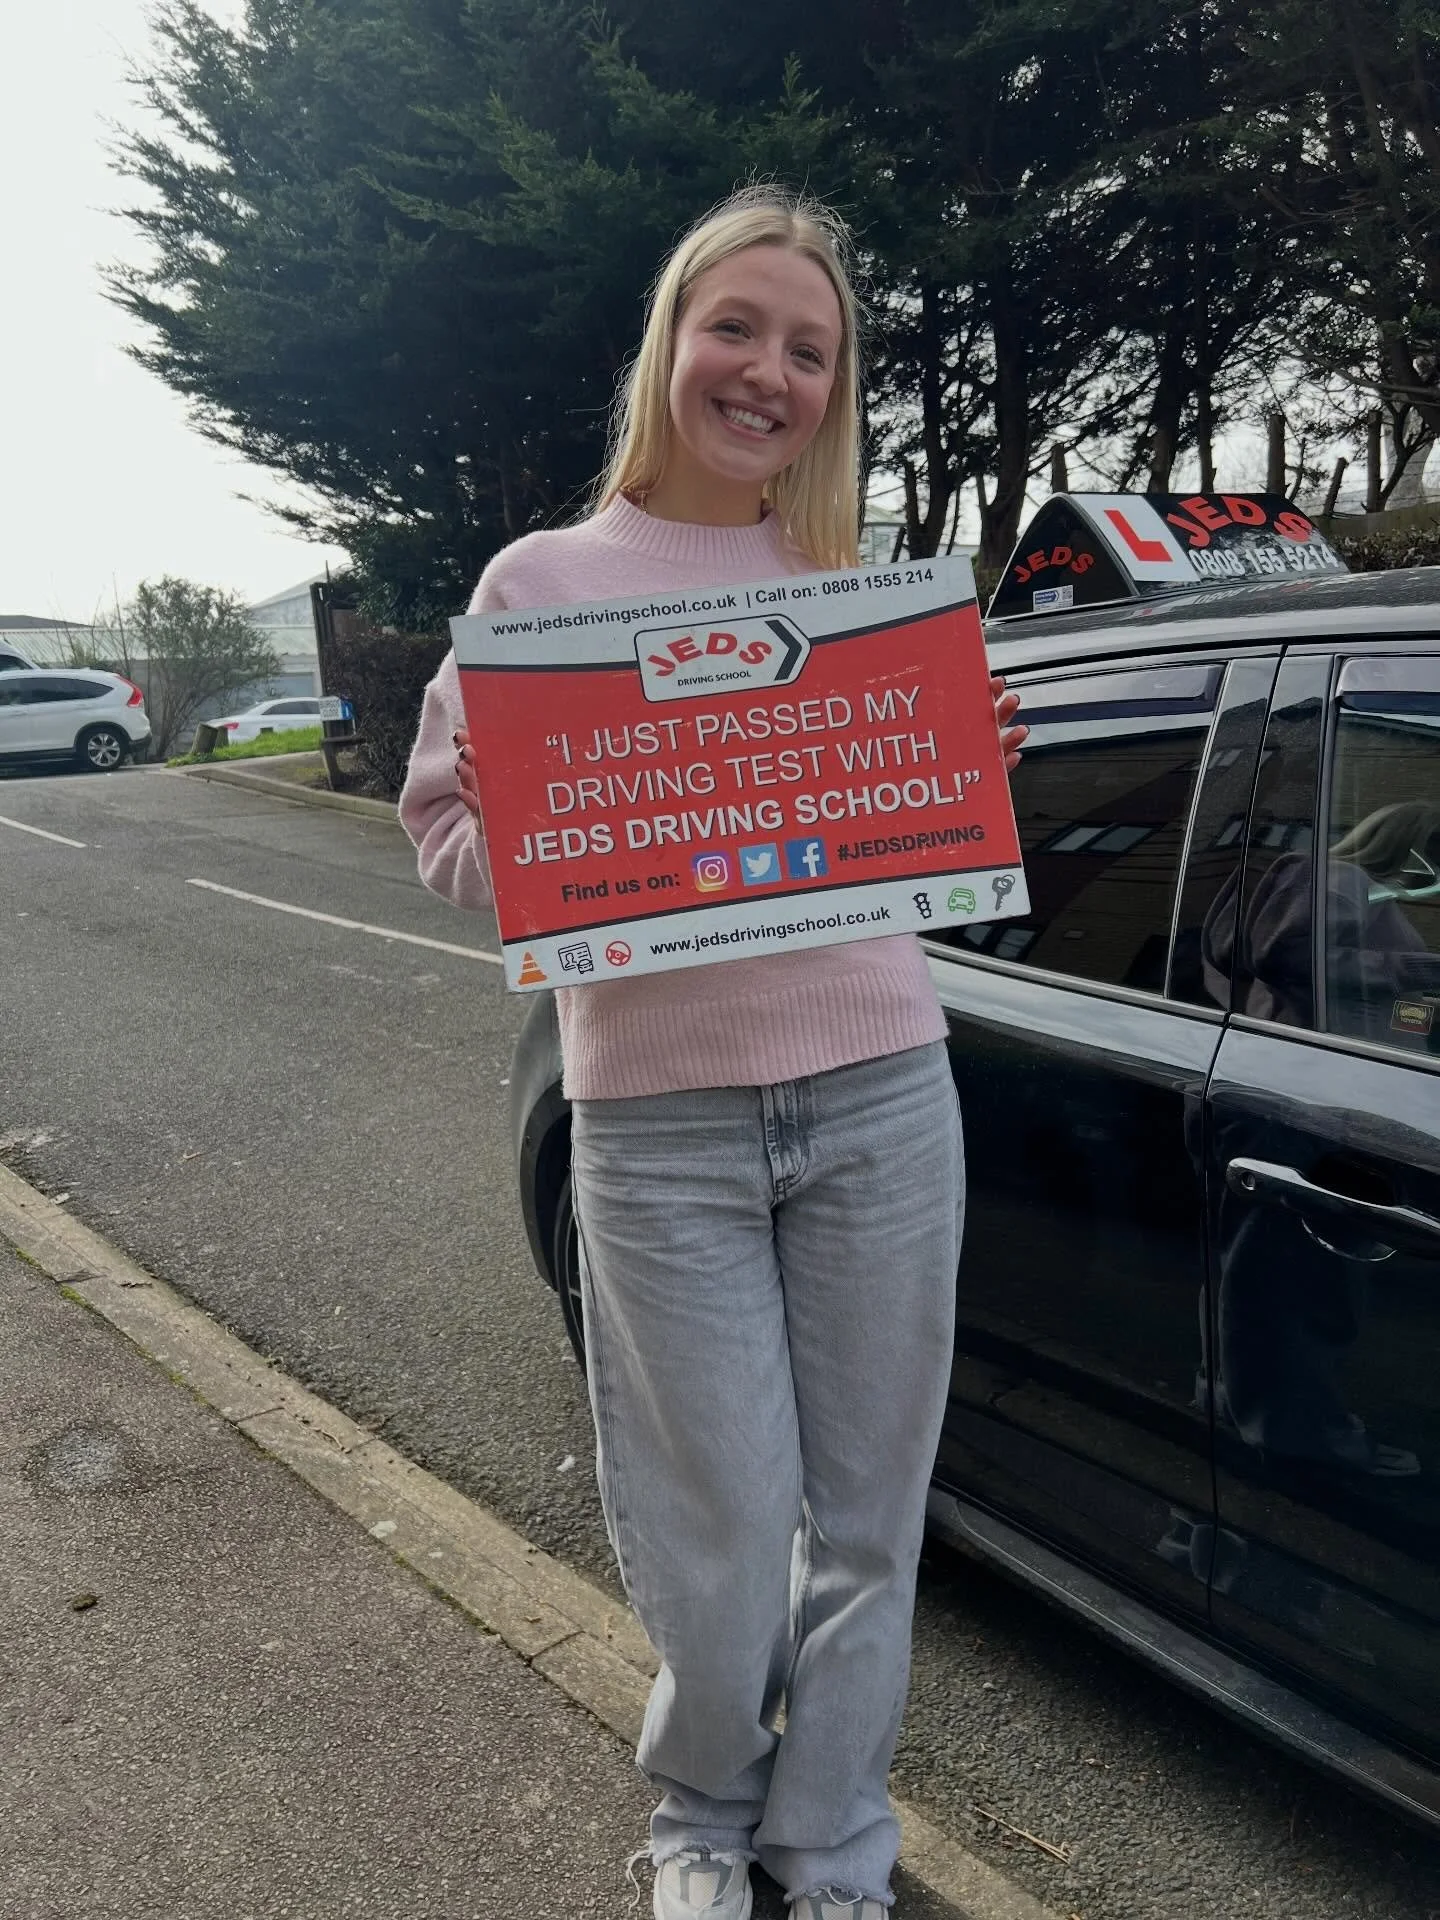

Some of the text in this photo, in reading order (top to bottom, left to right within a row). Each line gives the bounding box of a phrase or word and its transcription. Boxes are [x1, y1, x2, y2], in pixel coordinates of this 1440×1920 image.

[1103, 508, 1173, 562] L
[1167, 496, 1314, 548] JEDS
[1014, 547, 1095, 583] JEDS
[1191, 544, 1338, 575] 0808 155 5214
[492, 594, 737, 638] www.jedsdrivingschool.co.uk
[755, 586, 787, 604] Call
[792, 584, 817, 601] on:
[821, 576, 860, 594] 0808
[864, 571, 901, 590] 1555
[905, 569, 934, 585] 214
[646, 631, 772, 676] JEDS
[678, 670, 752, 687] DRIVING SCHOOL
[588, 718, 684, 760] JUST
[696, 696, 853, 748] PASSED
[865, 686, 921, 721] MY
[548, 730, 938, 815] DRIVING TEST WITH
[514, 823, 613, 865] JEDS
[626, 798, 784, 850] DRIVING
[836, 824, 985, 862] #JEDSDRIVING
[562, 870, 680, 902] Find us on:
[650, 906, 891, 956] www.jedsdrivingschool.co.uk
